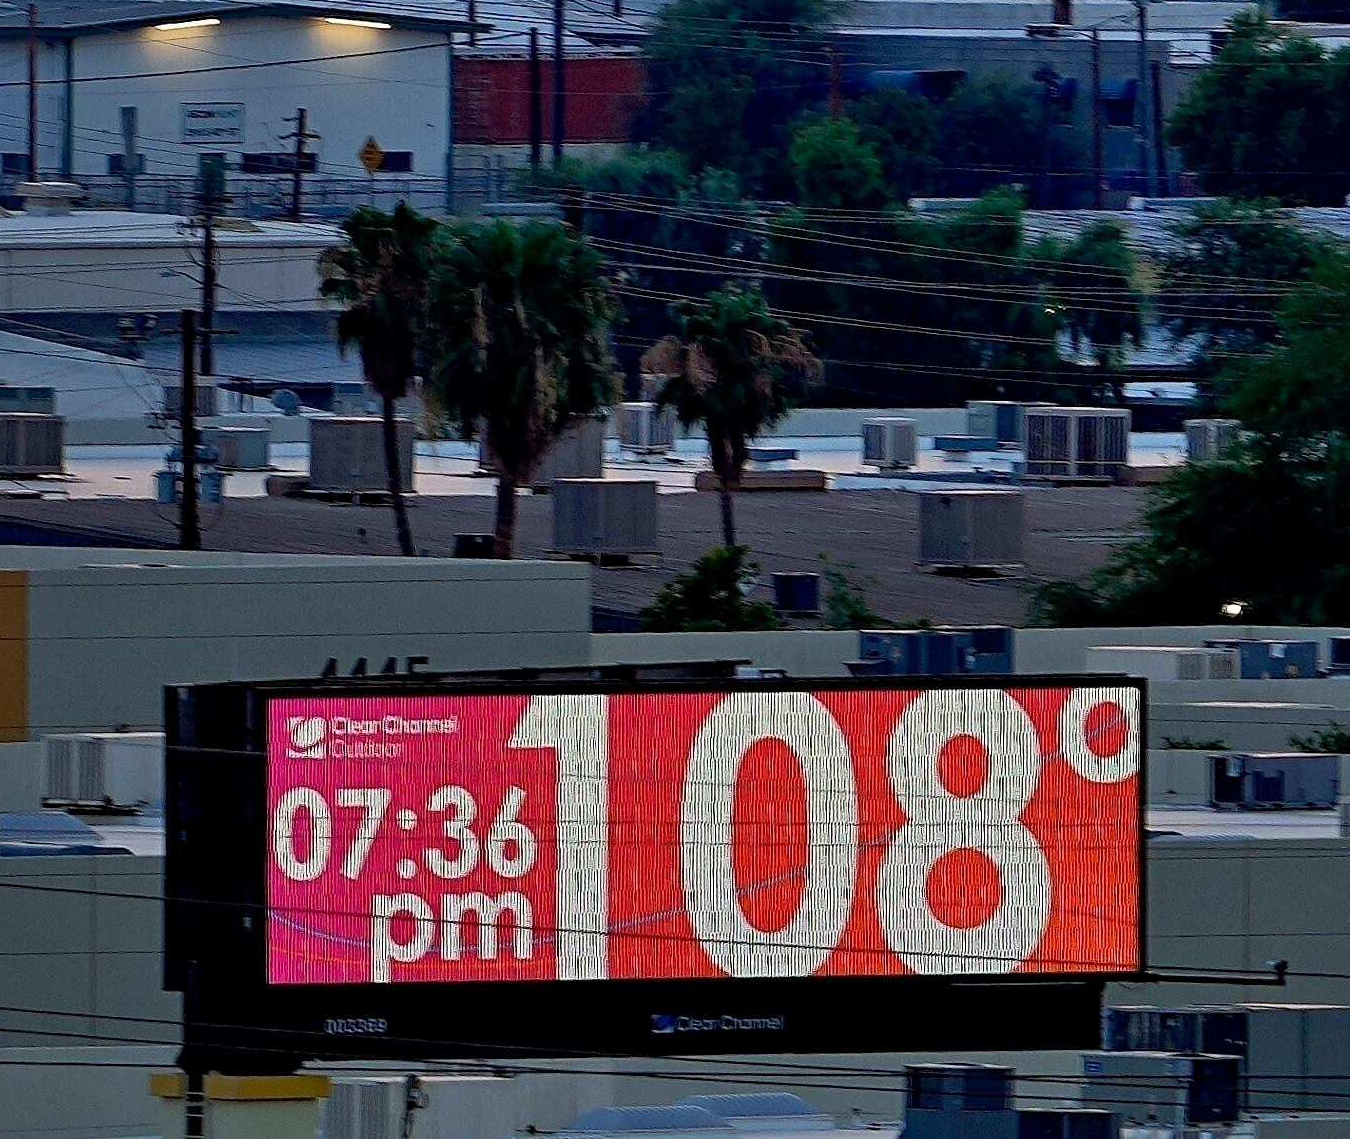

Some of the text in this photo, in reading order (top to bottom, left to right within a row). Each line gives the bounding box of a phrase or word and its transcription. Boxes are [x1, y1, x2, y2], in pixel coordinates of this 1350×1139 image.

[331, 715, 459, 734] Clear Channel
[331, 738, 402, 758] Outdoor
[273, 785, 538, 882] 07:36
[371, 891, 533, 984] pm
[677, 1015, 784, 1030] Clear Channel
